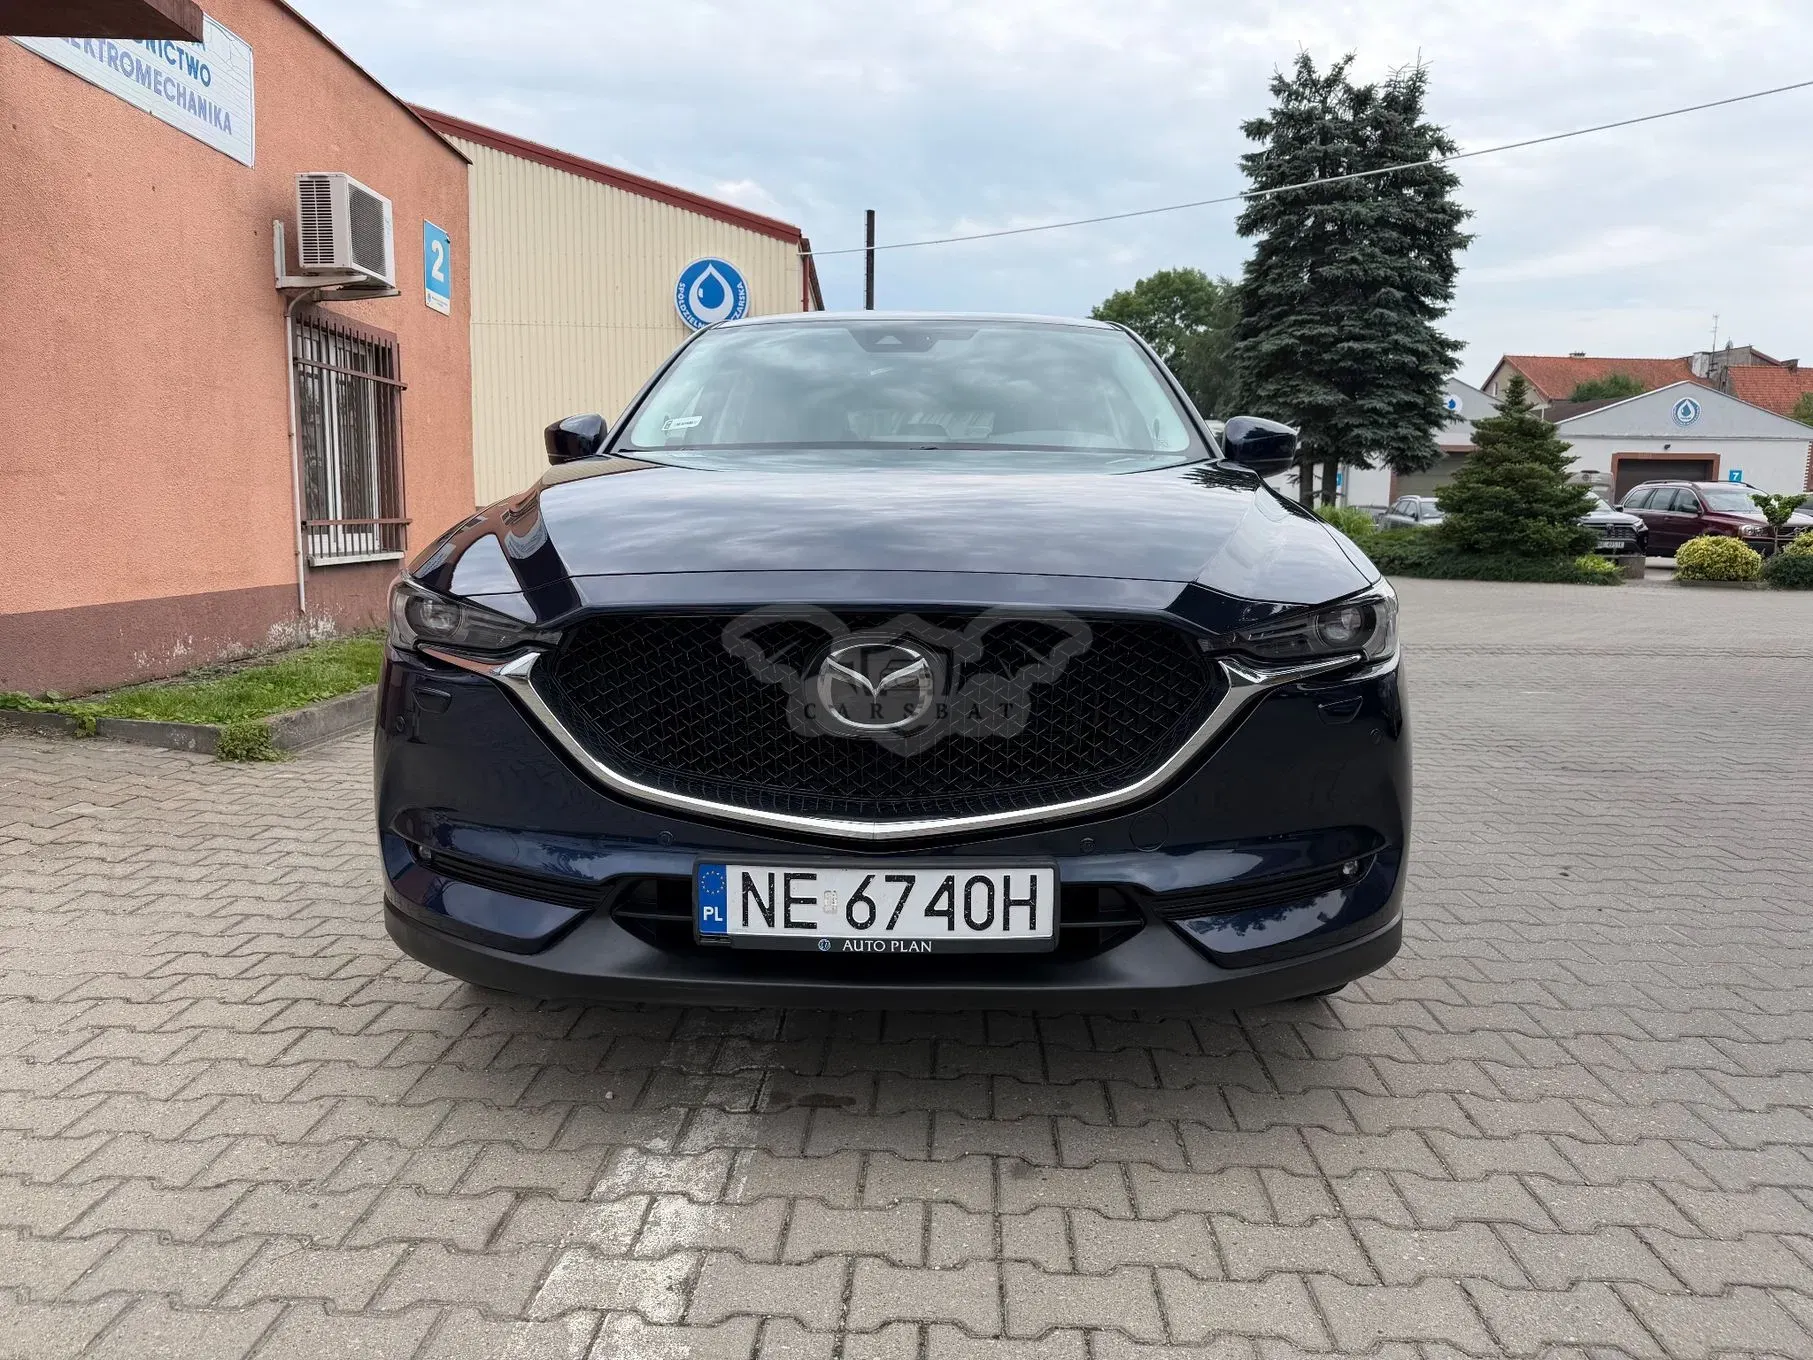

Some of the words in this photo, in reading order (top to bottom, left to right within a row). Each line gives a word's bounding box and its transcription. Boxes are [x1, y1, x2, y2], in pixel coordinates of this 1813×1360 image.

[432, 240, 444, 282] 2
[1732, 472, 1740, 480] 7
[741, 871, 818, 929] NE
[846, 874, 1037, 931] 6740H
[703, 906, 723, 922] PL
[842, 940, 886, 952] AUTO
[891, 940, 932, 953] PLAN
